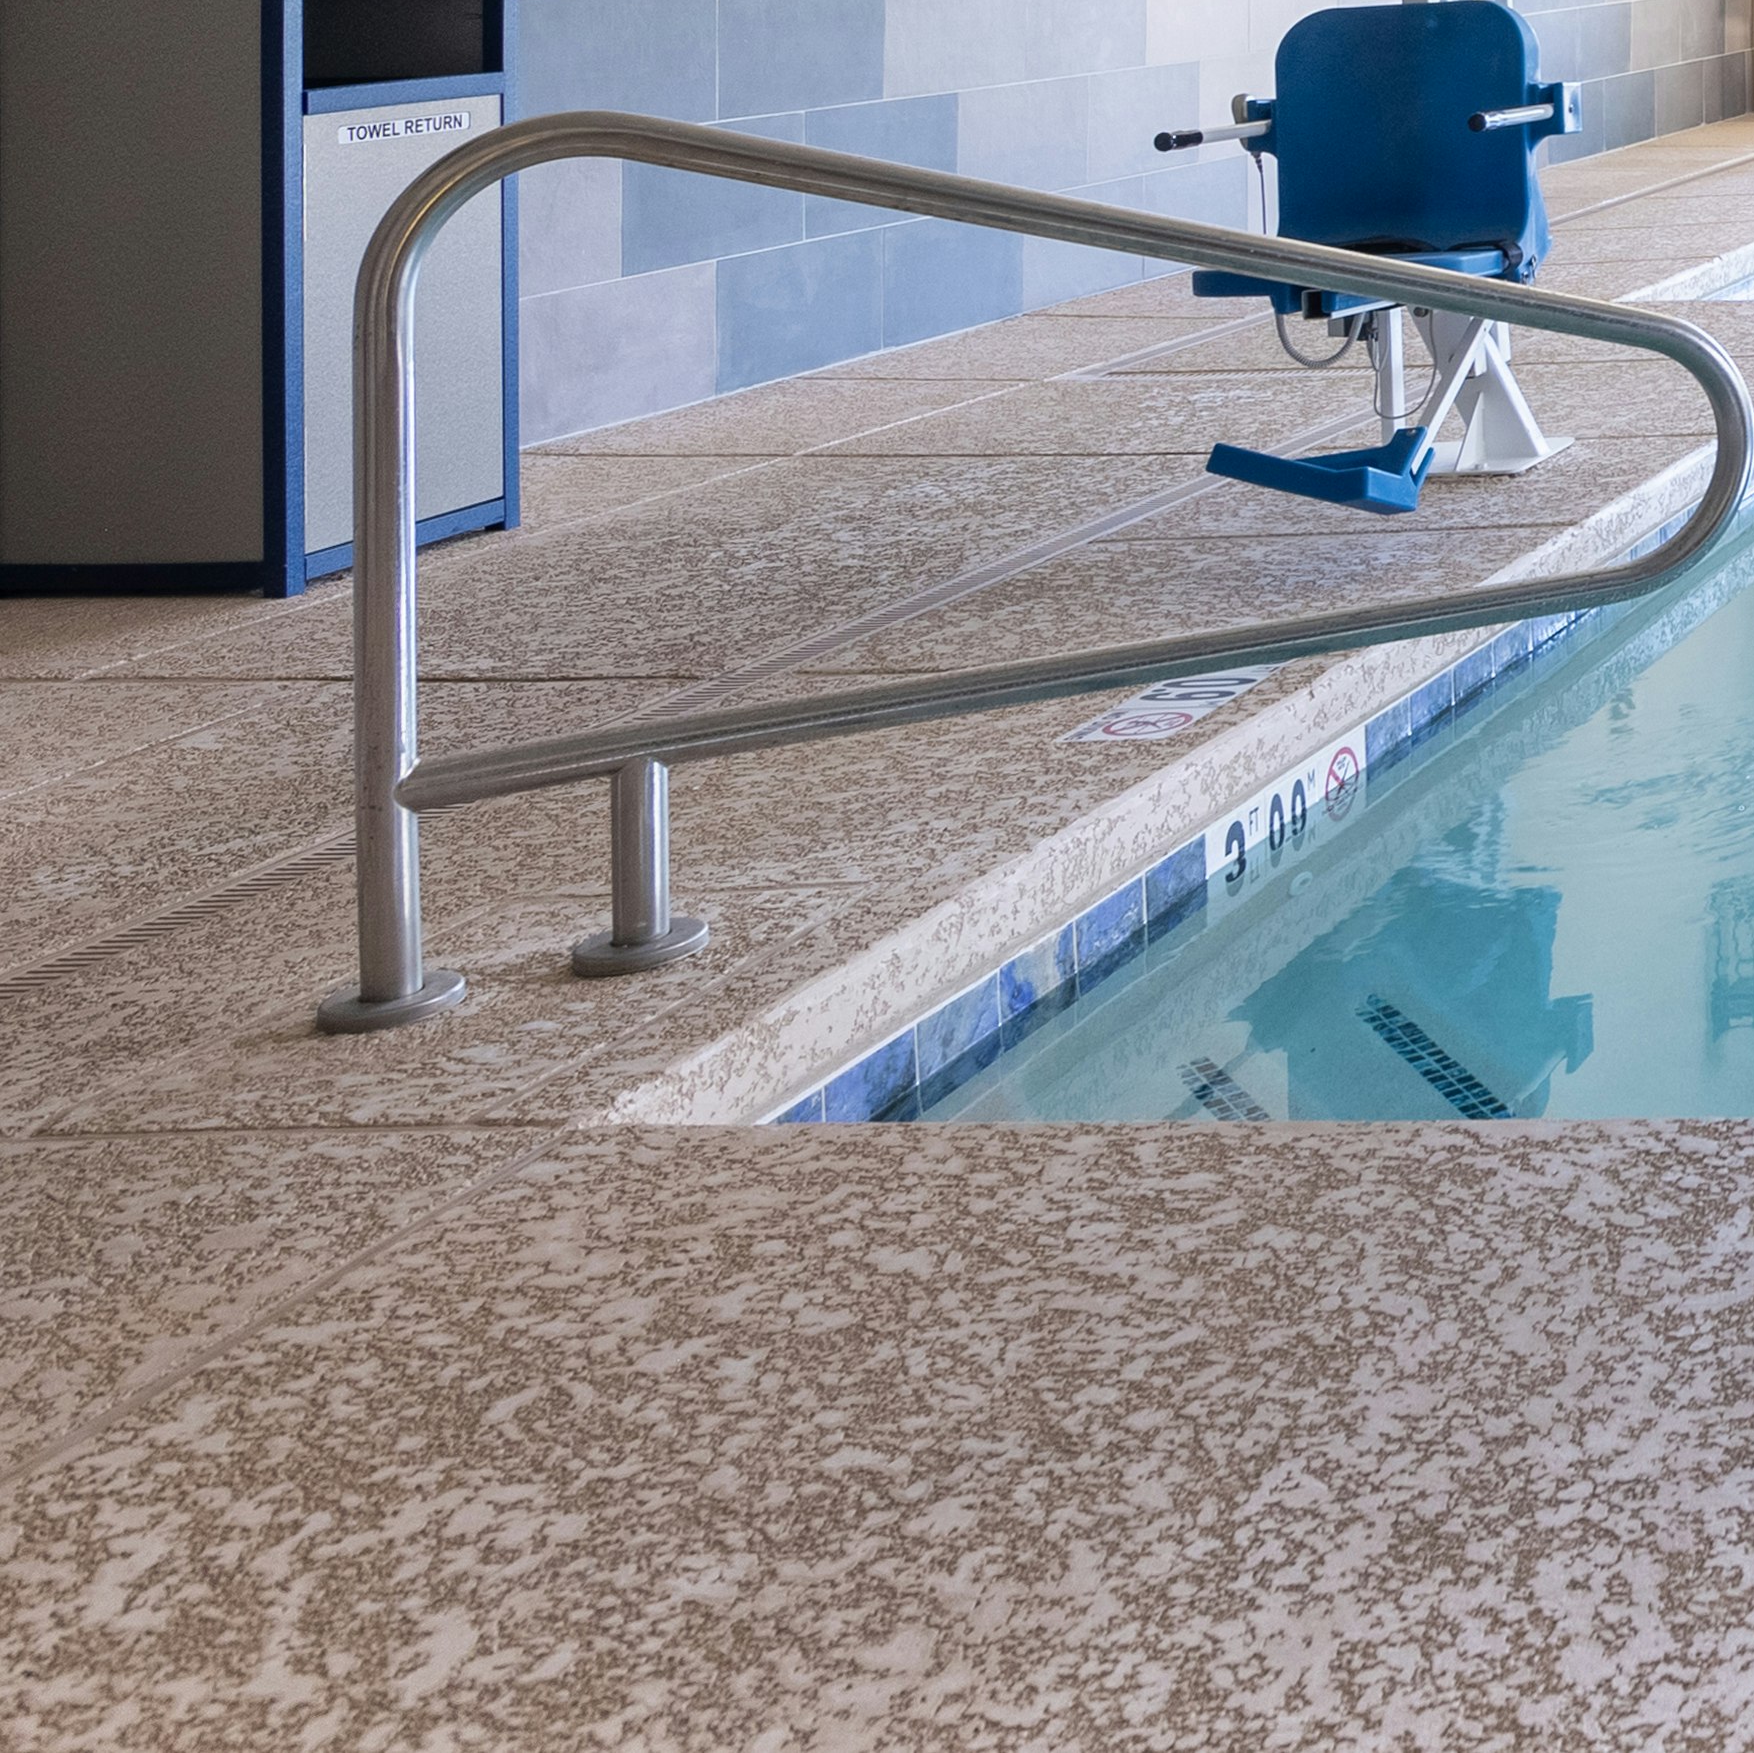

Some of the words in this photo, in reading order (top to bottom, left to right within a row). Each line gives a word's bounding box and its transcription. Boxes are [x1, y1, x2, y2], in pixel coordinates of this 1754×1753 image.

[348, 123, 400, 141] TOWEL
[405, 115, 463, 134] RETURN
[1225, 820, 1245, 882] 3
[1248, 806, 1259, 833] FT
[1308, 773, 1316, 791] M
